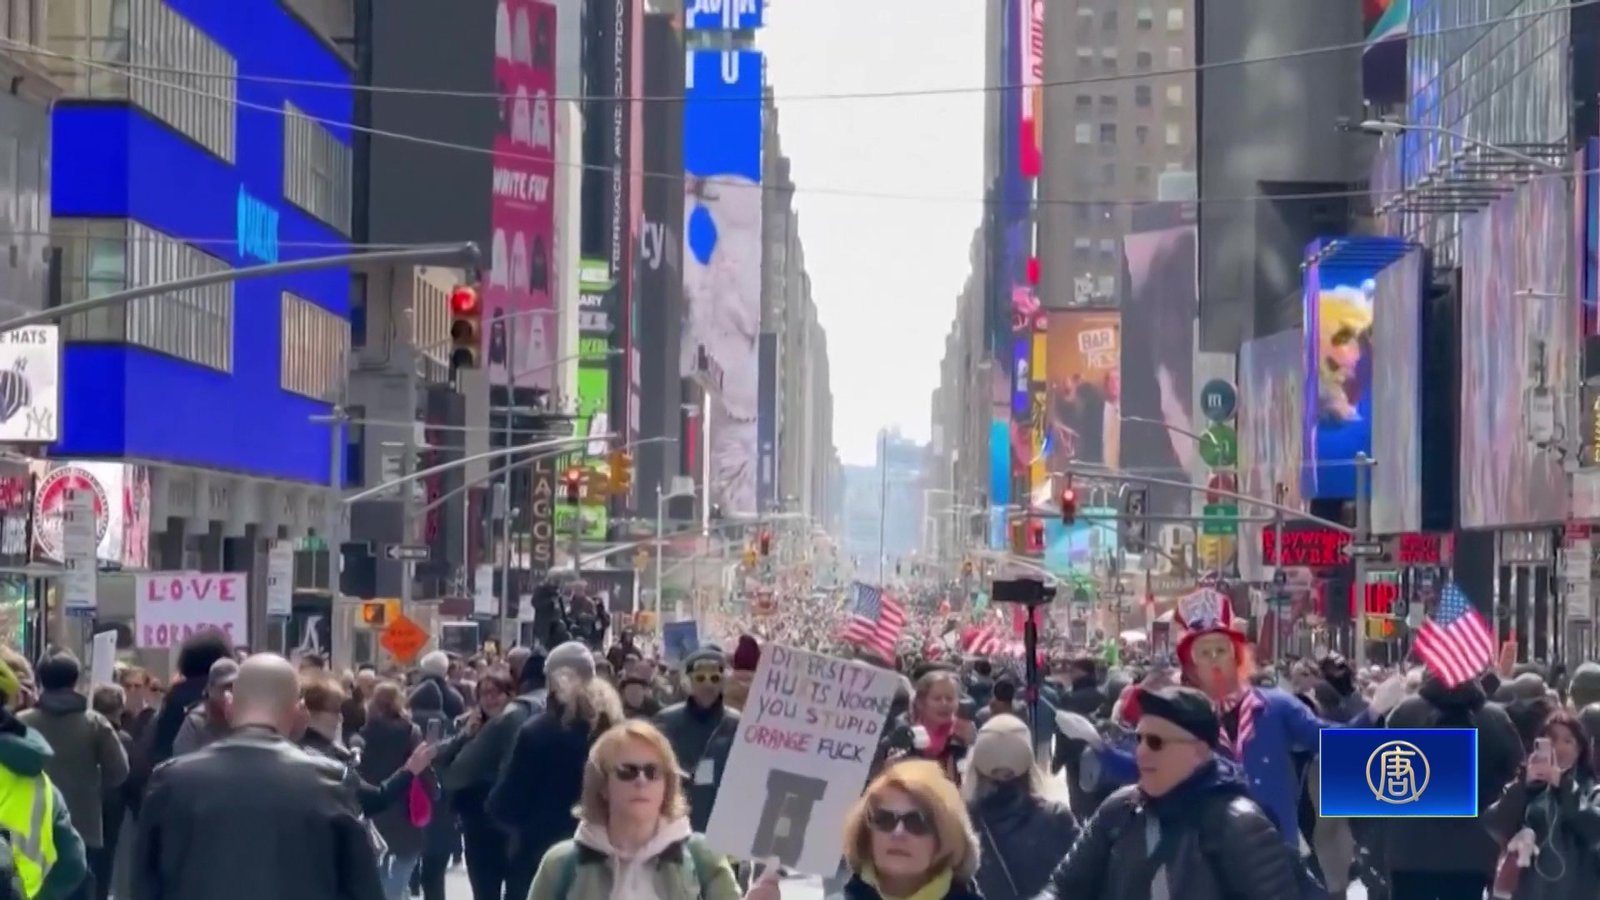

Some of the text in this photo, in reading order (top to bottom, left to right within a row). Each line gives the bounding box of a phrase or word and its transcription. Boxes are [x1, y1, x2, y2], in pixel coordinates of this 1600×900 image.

[10, 330, 47, 344] HATS
[755, 695, 878, 735] YOU STUPID
[744, 725, 866, 763] ORANGE FUCK
